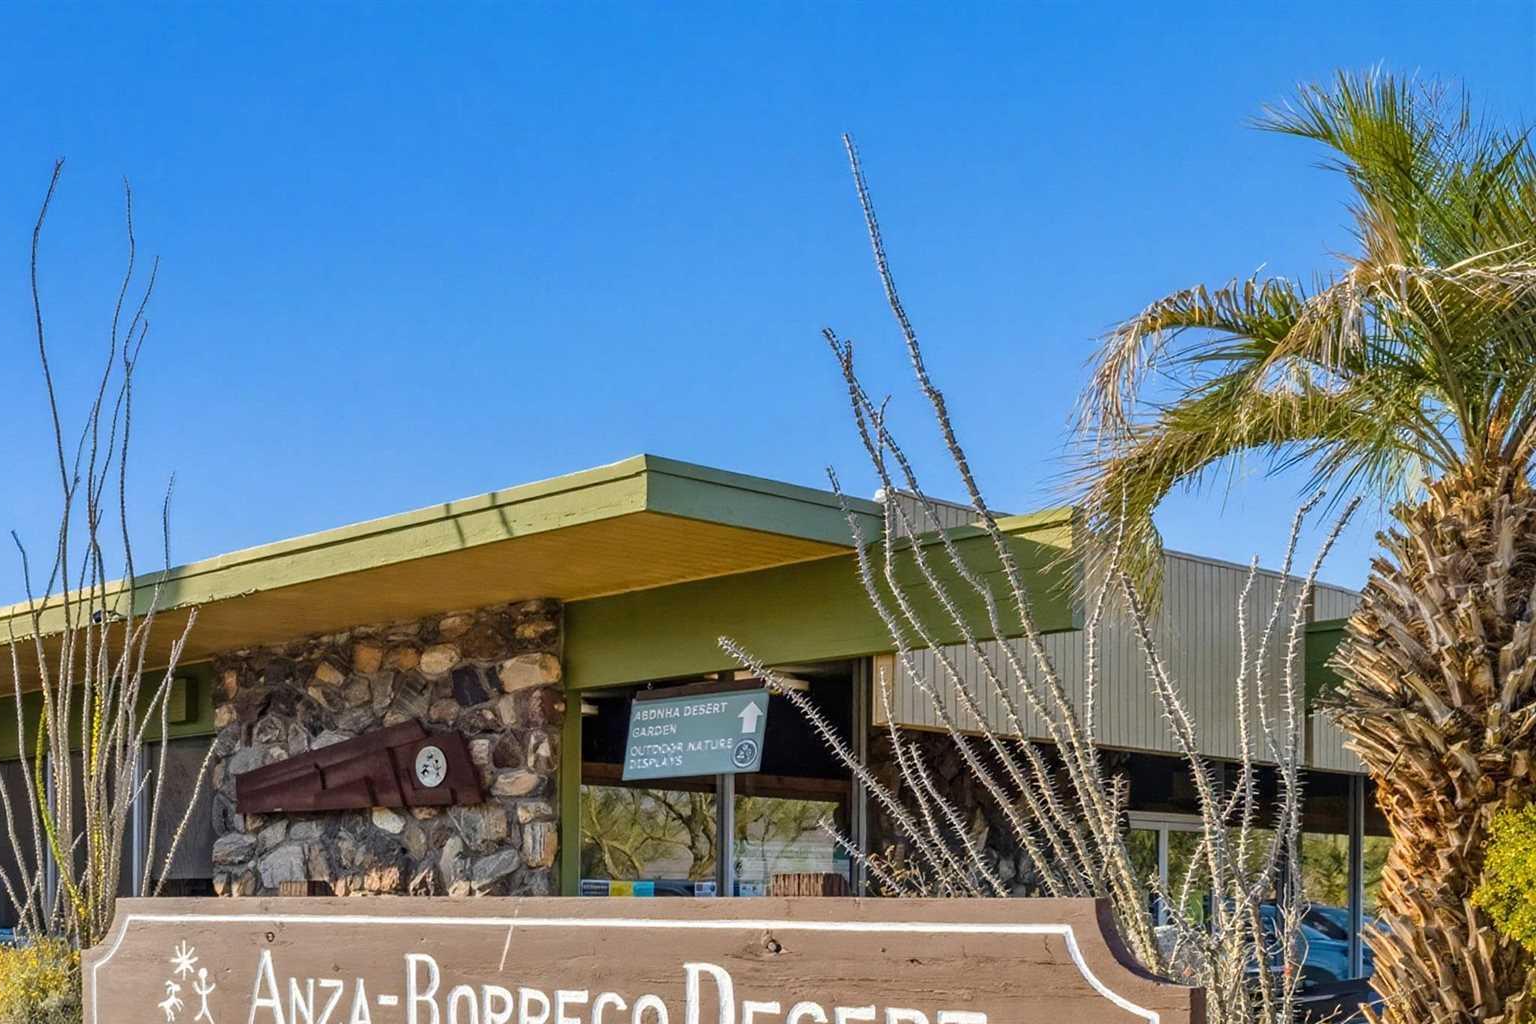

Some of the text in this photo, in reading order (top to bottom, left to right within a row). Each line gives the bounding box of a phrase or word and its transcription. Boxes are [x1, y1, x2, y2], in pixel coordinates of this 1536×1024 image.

[633, 702, 728, 722] ABDNHA DESERT
[632, 724, 677, 738] GARDEN
[630, 738, 734, 757] OUTDOOR NATURE
[629, 755, 683, 770] DISPLAYS
